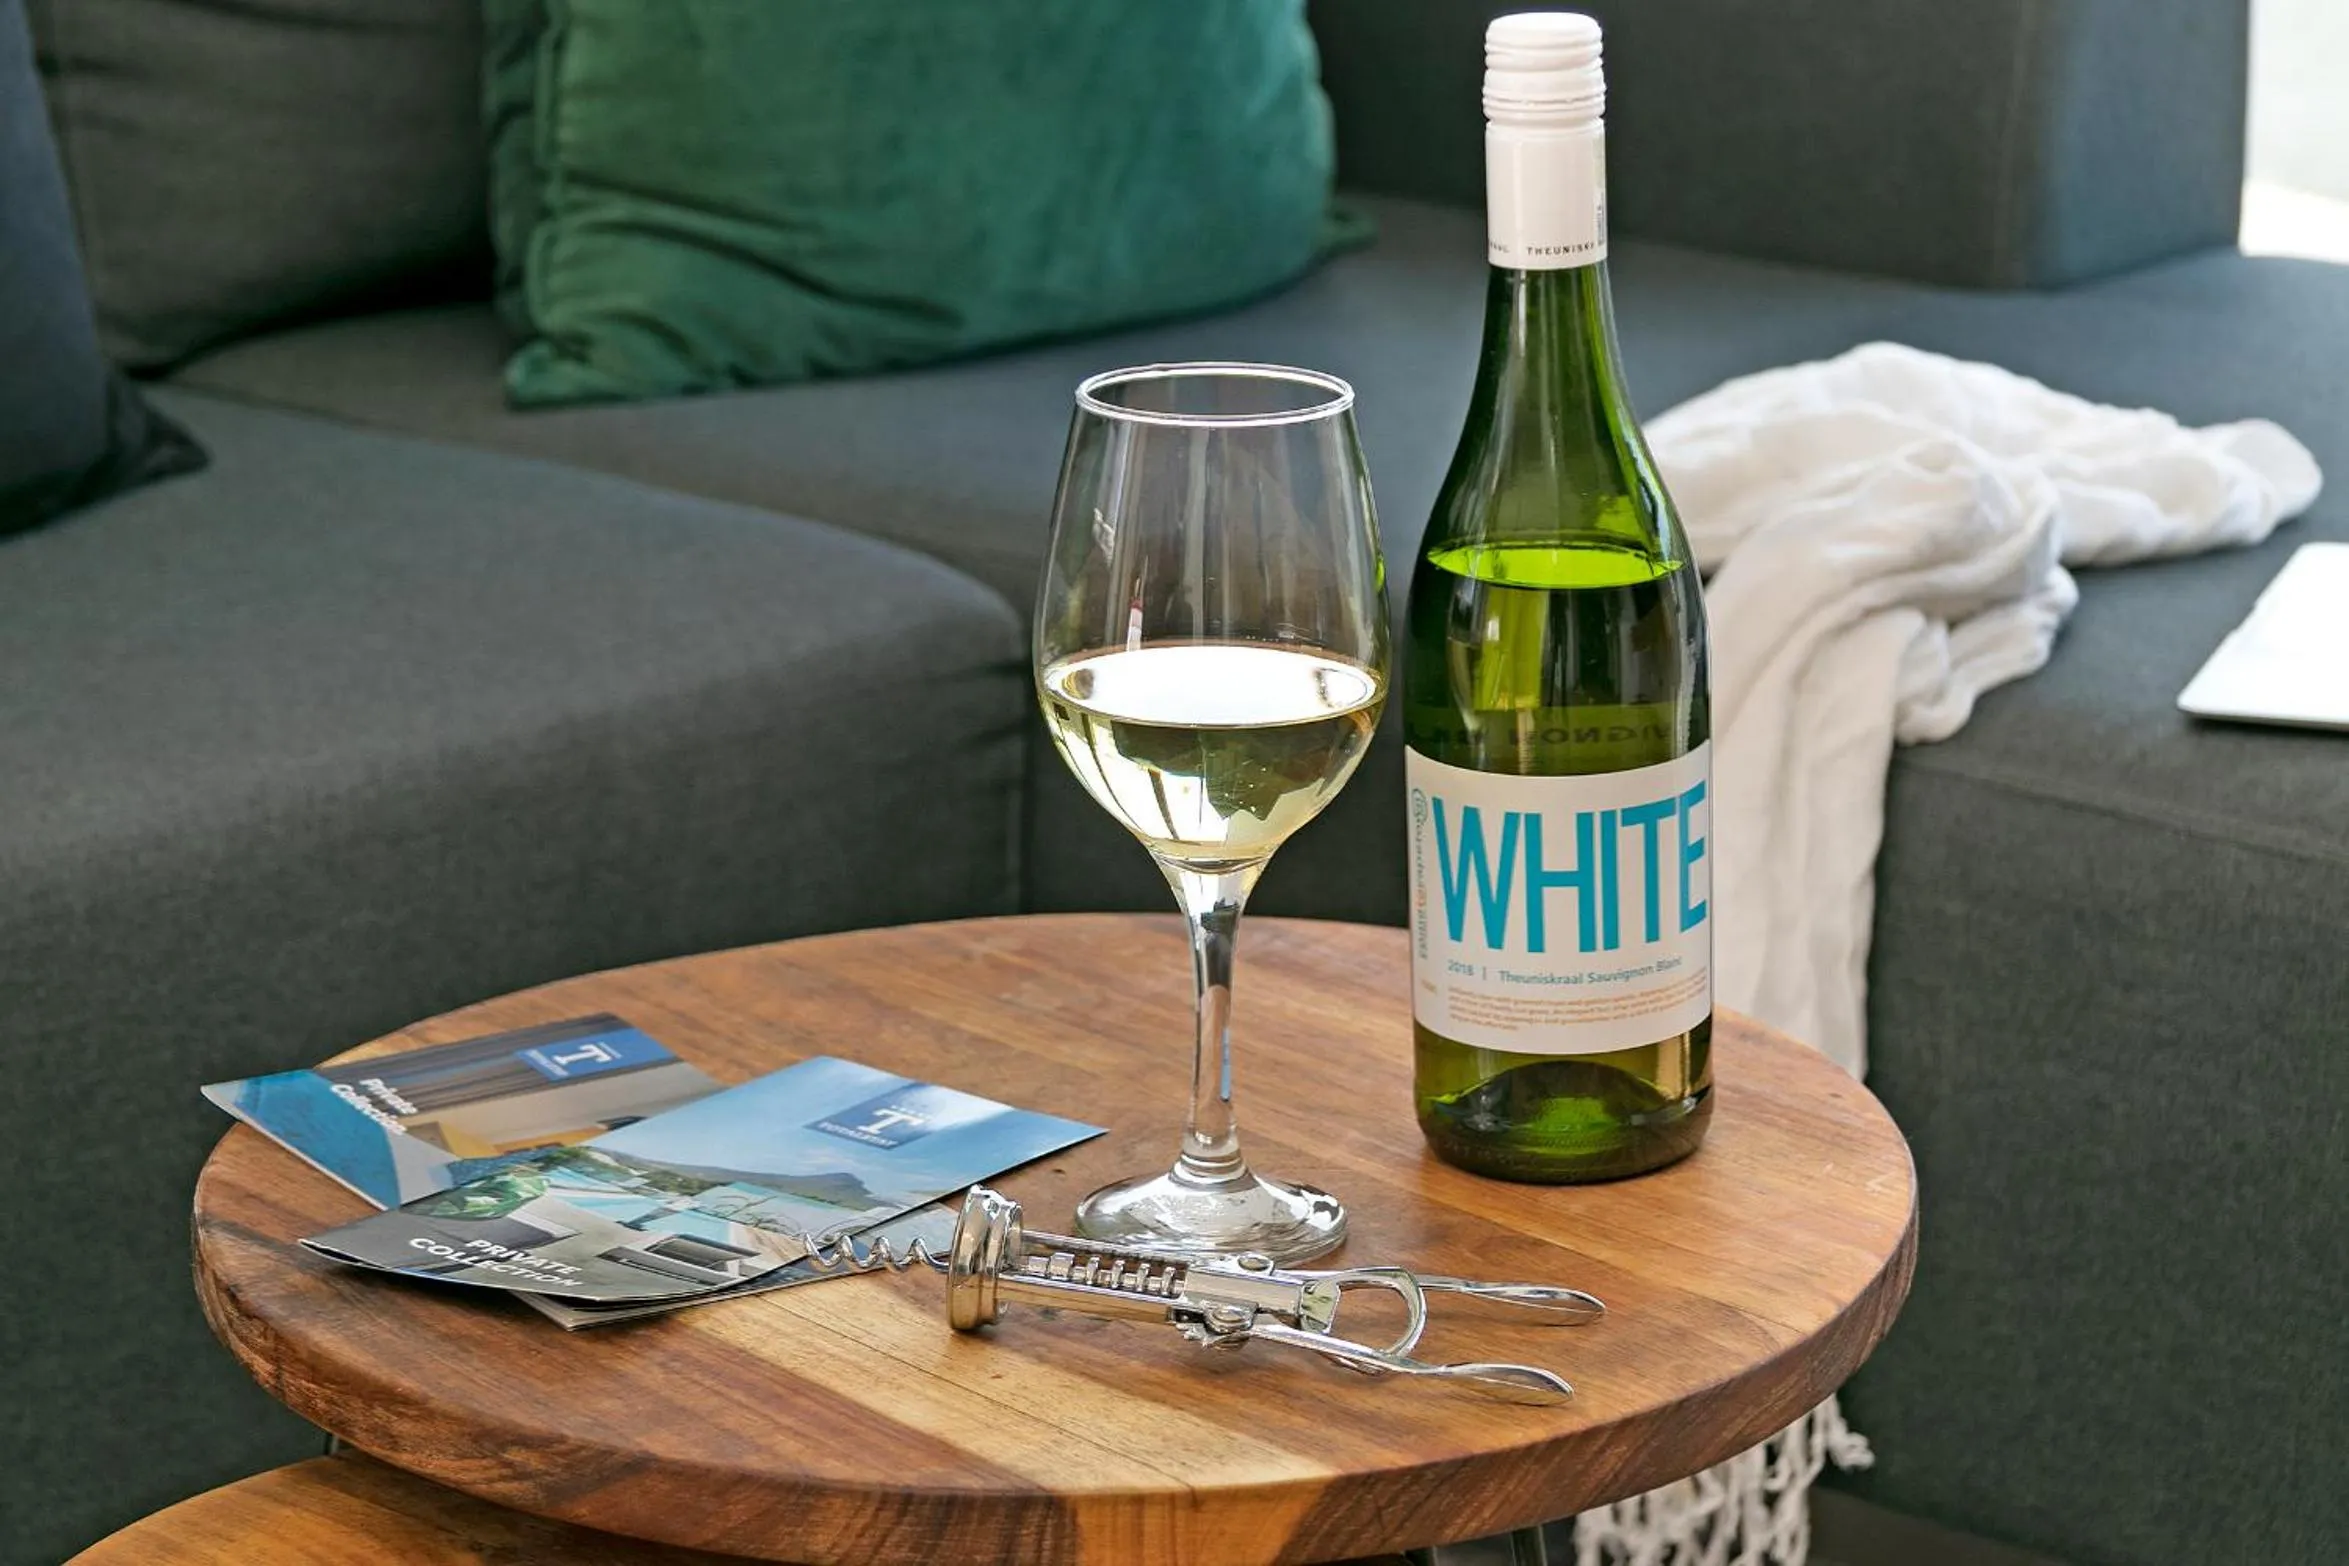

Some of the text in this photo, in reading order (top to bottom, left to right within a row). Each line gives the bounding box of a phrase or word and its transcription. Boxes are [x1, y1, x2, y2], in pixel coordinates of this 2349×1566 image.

[1432, 779, 1708, 953] WHITE
[1498, 970, 1584, 985] Theuniskraal
[1588, 965, 1655, 984] Sauvignon
[409, 1237, 584, 1287] COLLECTION
[465, 1239, 583, 1275] PRIVATE
